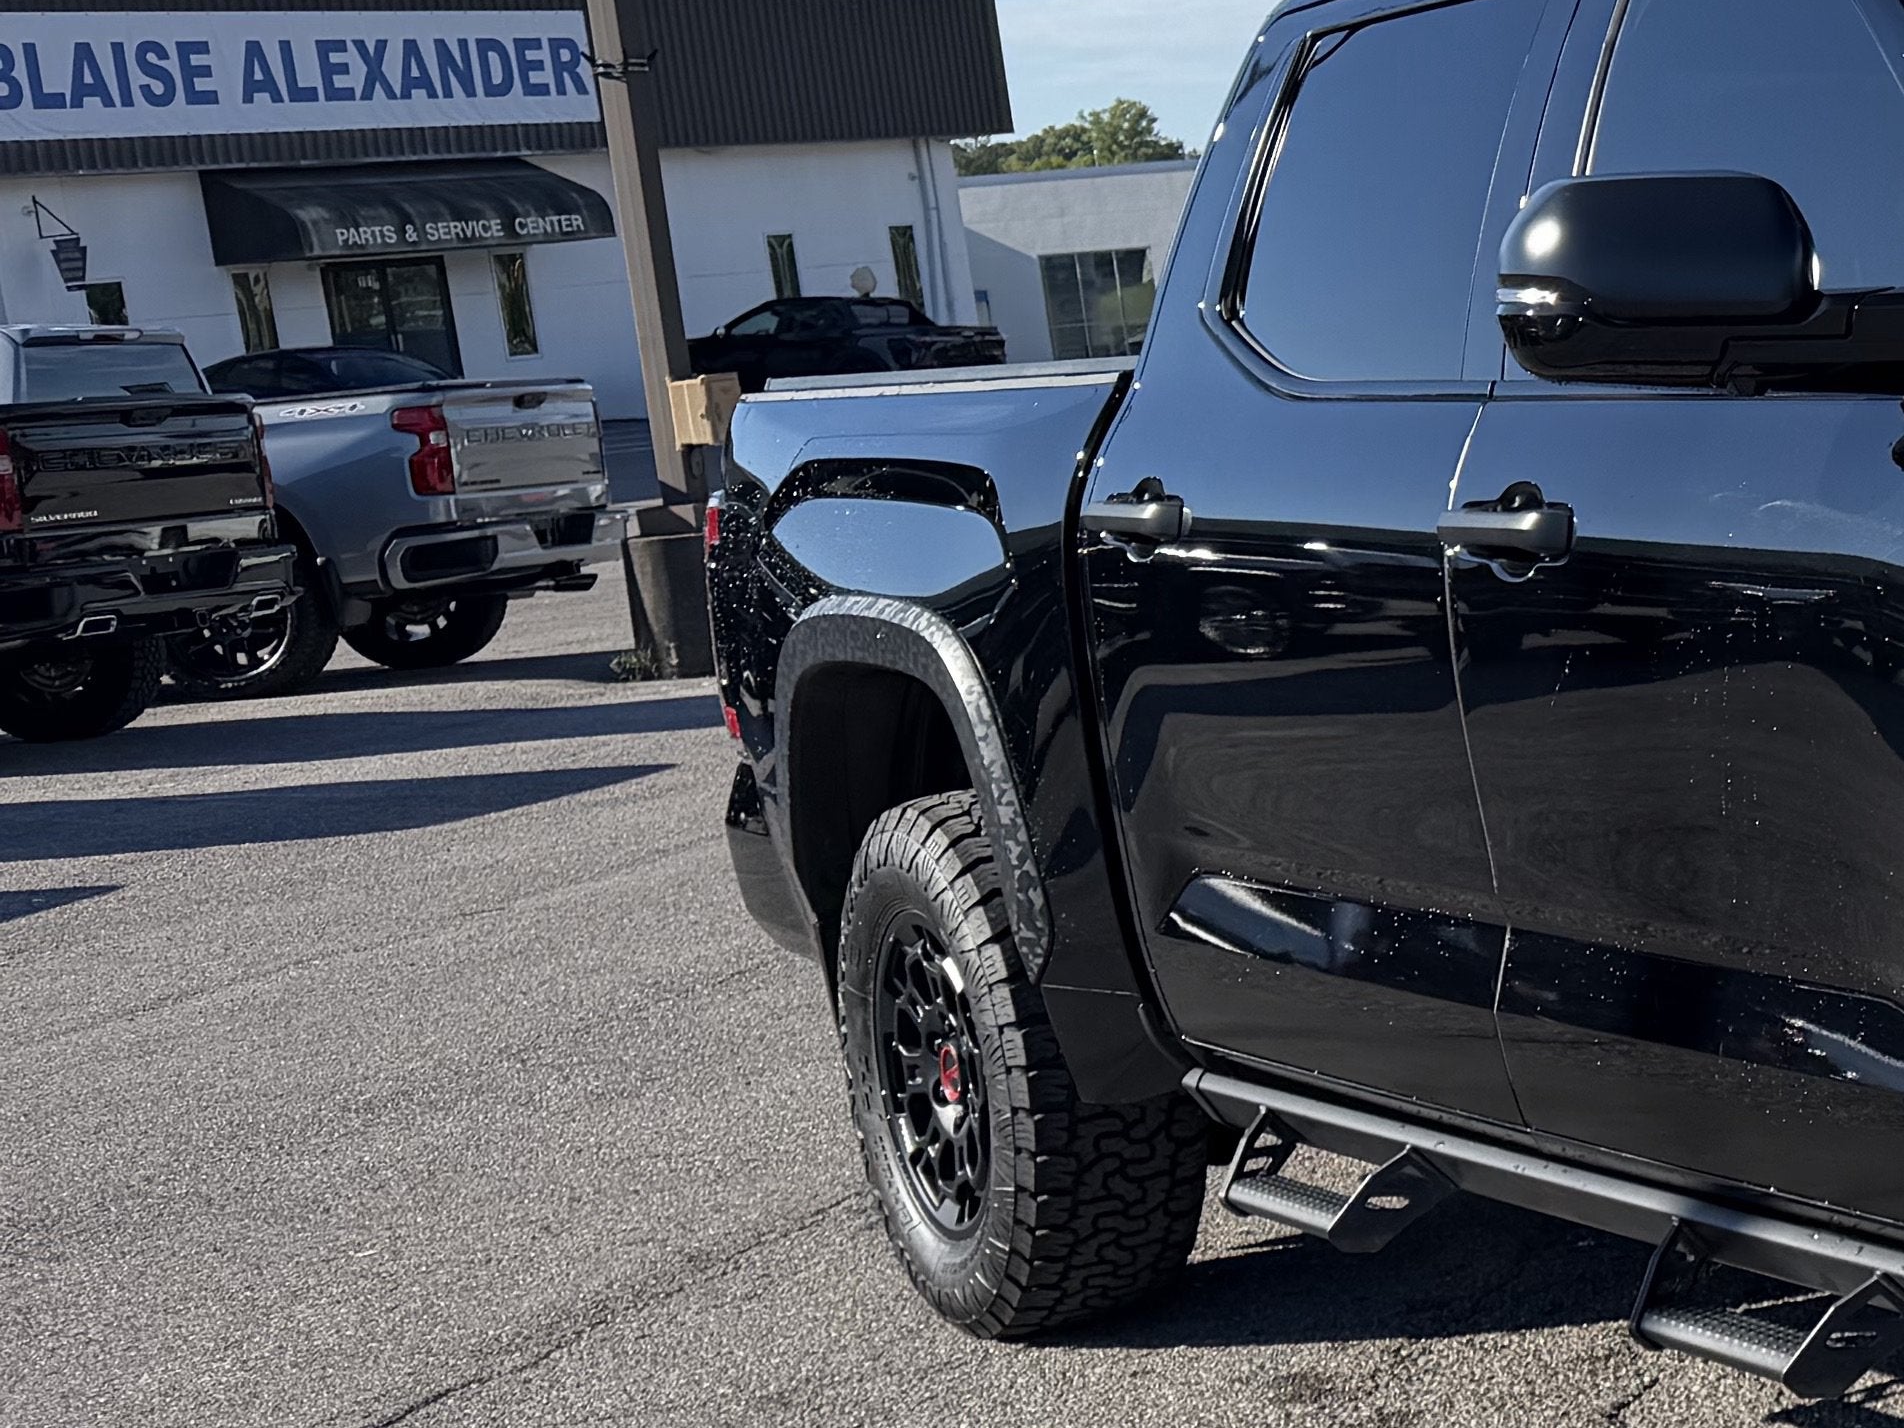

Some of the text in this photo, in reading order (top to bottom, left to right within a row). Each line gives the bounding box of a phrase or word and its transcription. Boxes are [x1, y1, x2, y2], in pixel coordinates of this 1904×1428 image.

[242, 37, 590, 104] ALEXANDER
[335, 215, 585, 246] PARTS & SERVICE CENTER
[465, 423, 598, 444] CHEVROLET
